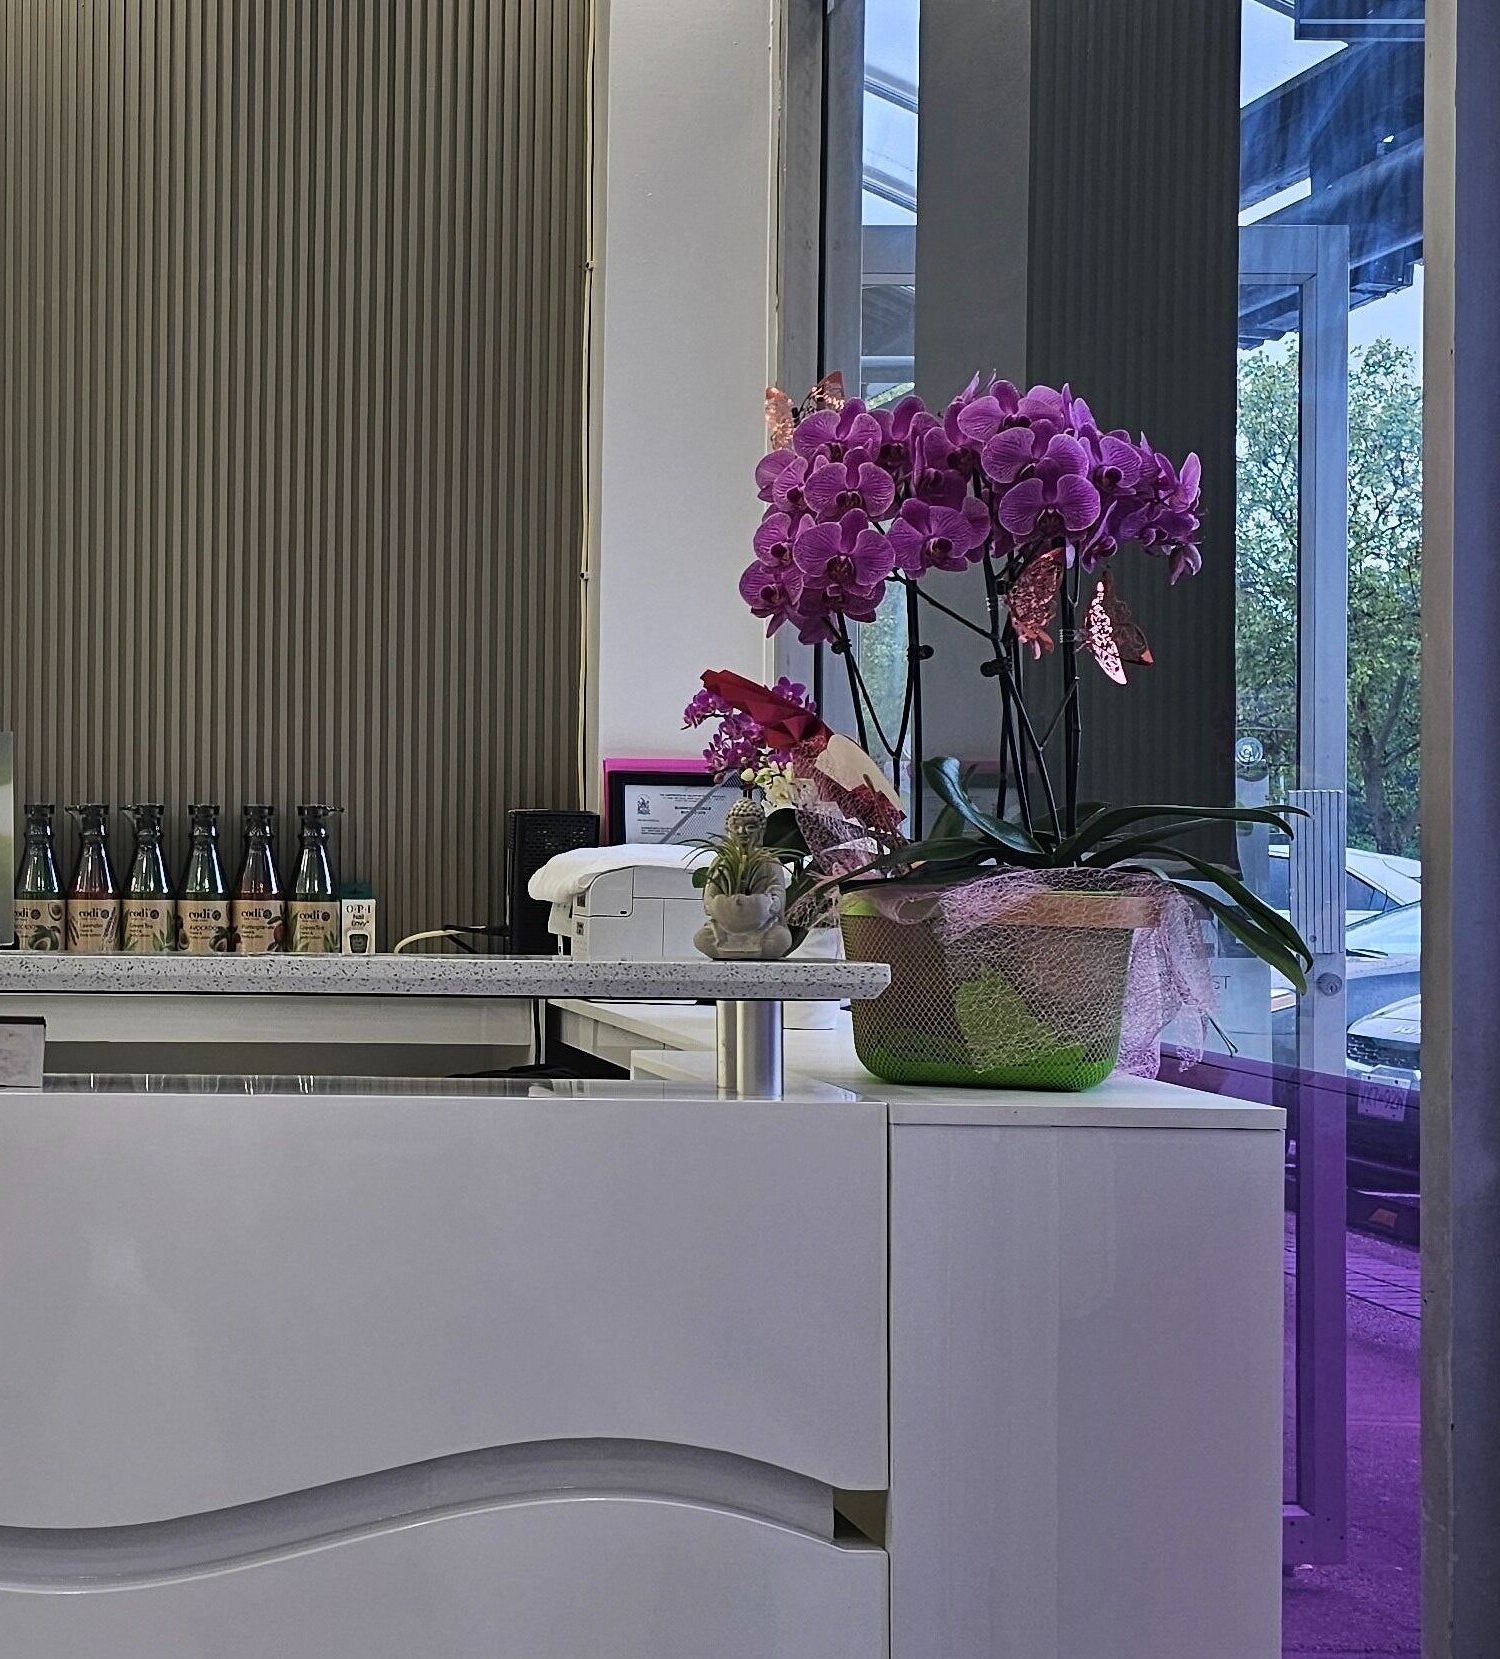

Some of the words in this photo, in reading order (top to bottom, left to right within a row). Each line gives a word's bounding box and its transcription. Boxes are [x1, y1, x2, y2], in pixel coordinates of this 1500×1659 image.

[79, 908, 99, 918] codi
[129, 908, 149, 918] codi
[188, 908, 210, 919] codi
[241, 908, 261, 918] codi
[299, 909, 321, 920] codi
